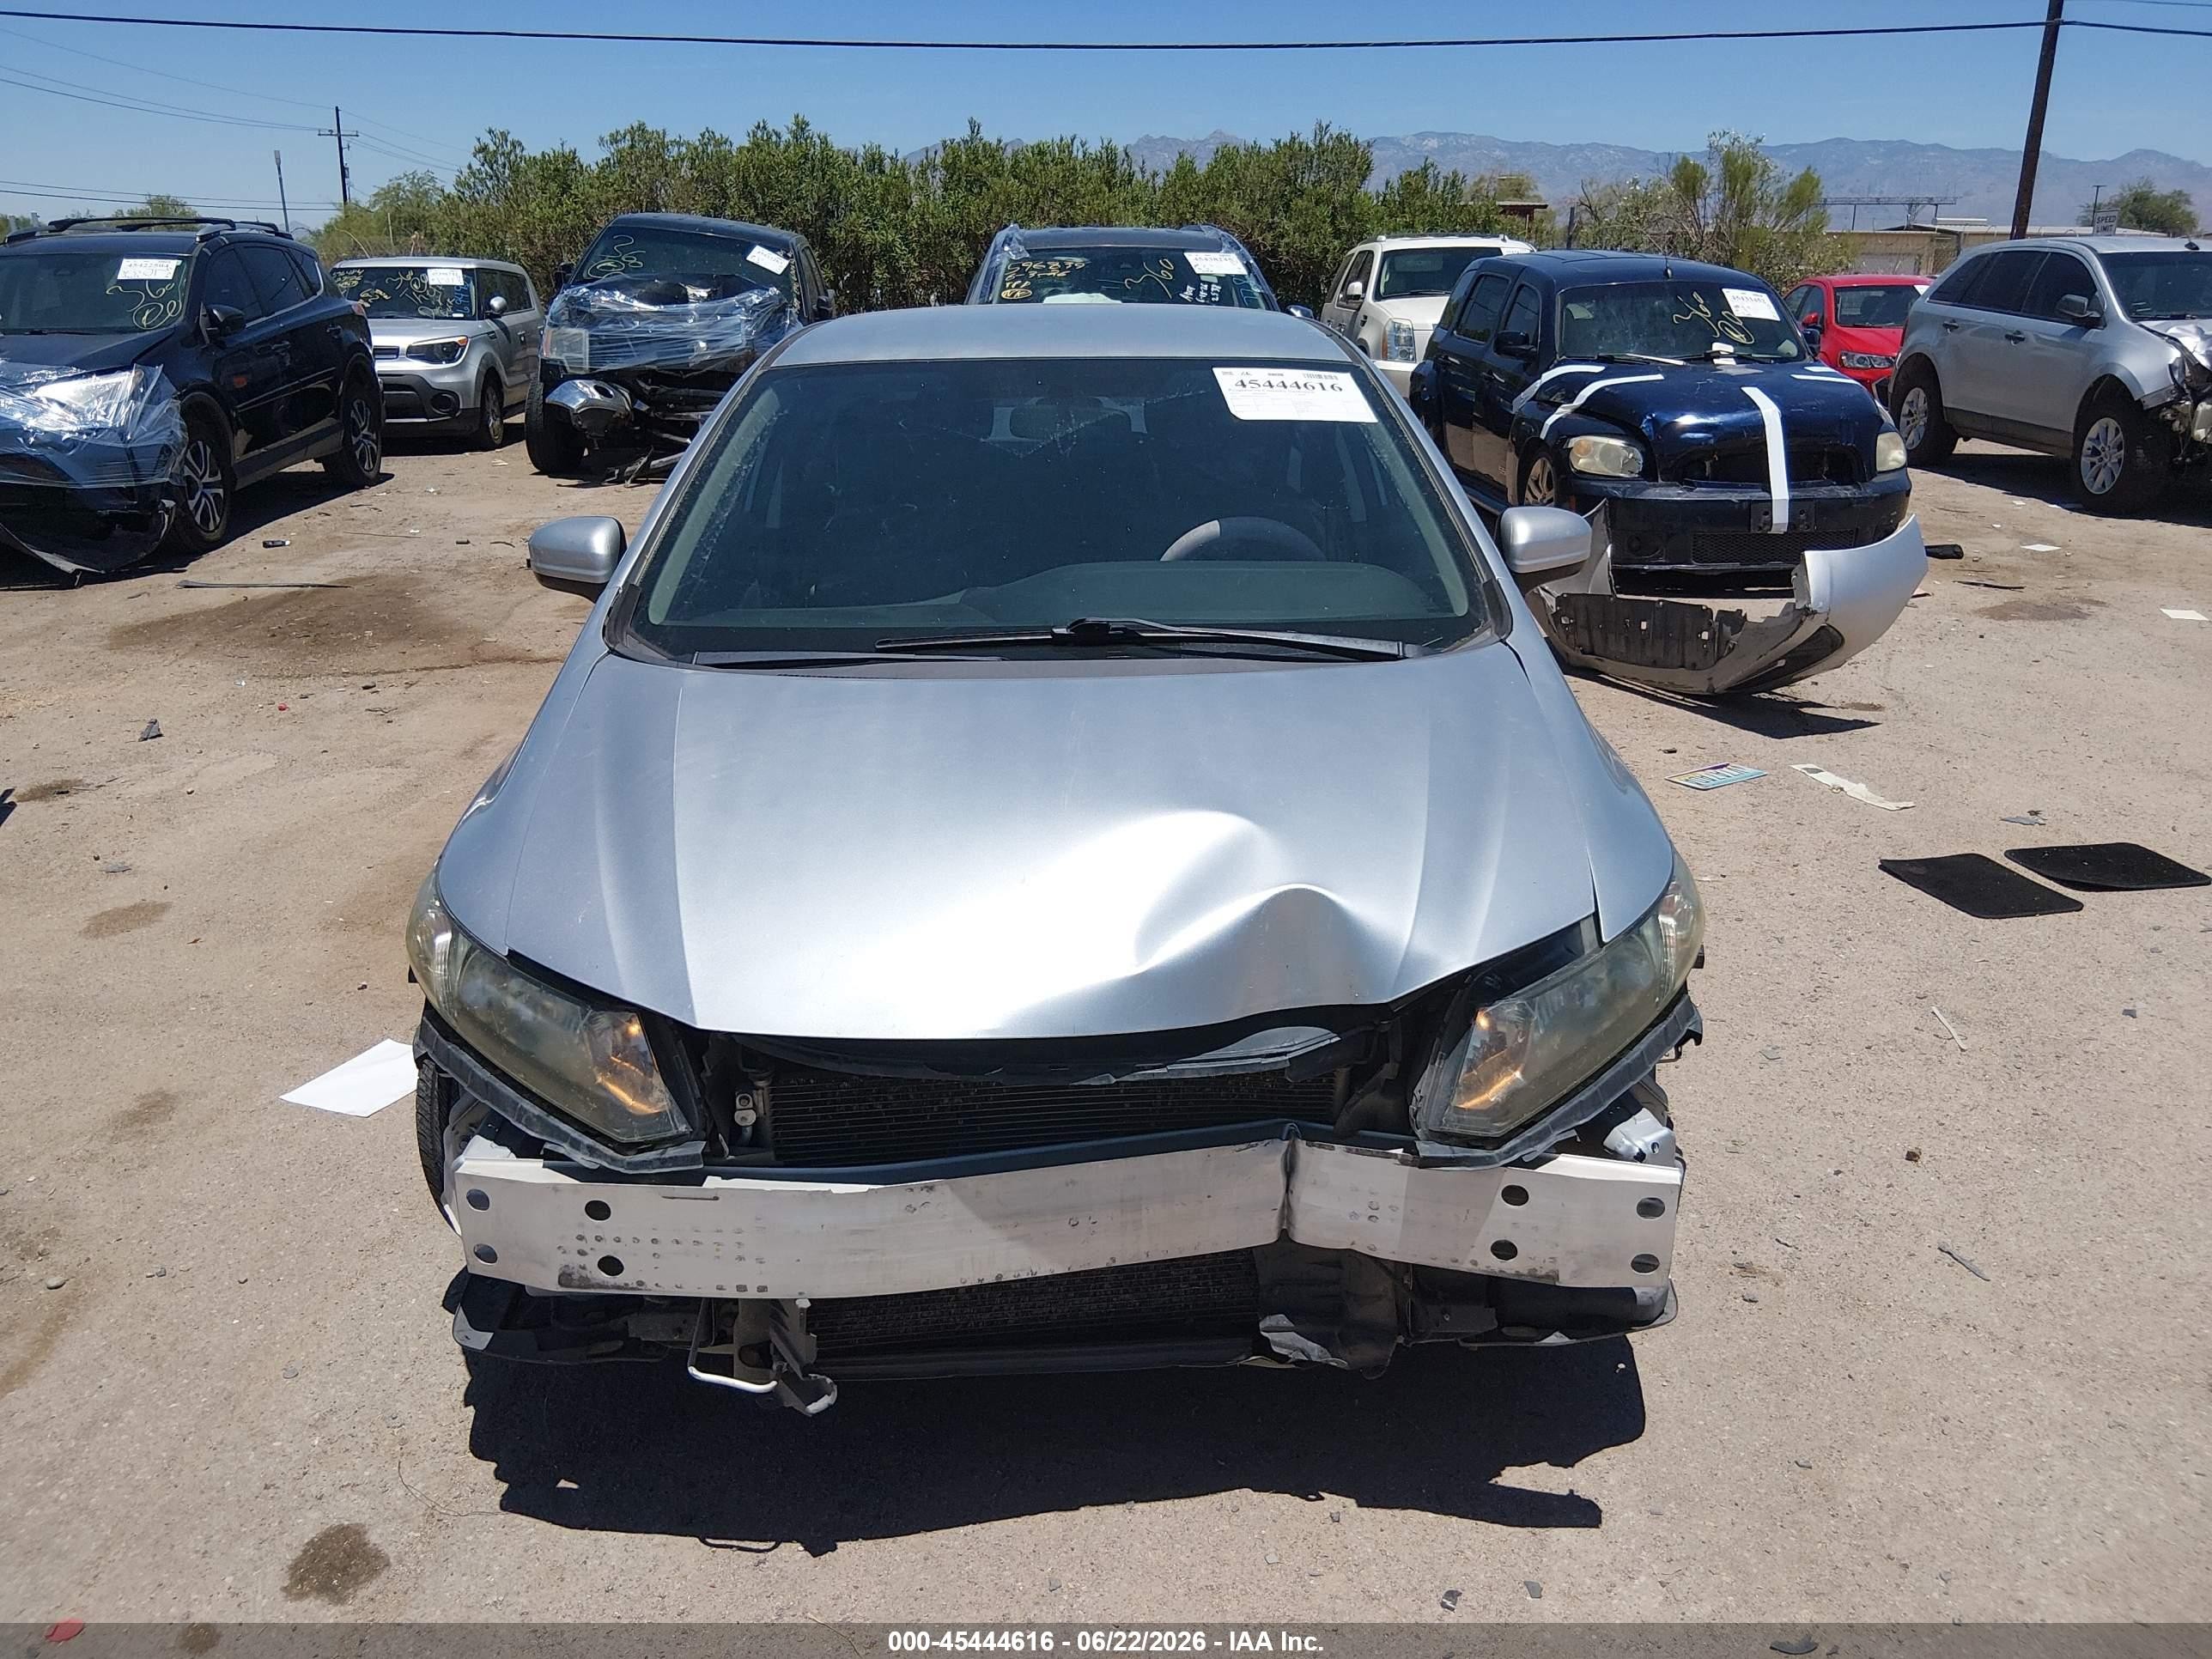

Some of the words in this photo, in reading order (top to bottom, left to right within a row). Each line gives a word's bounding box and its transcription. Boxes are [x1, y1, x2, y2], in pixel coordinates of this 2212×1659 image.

[2096, 215, 2117, 224] SPEED
[2096, 224, 2114, 234] LIMIT
[1234, 379, 1343, 392] 45444616
